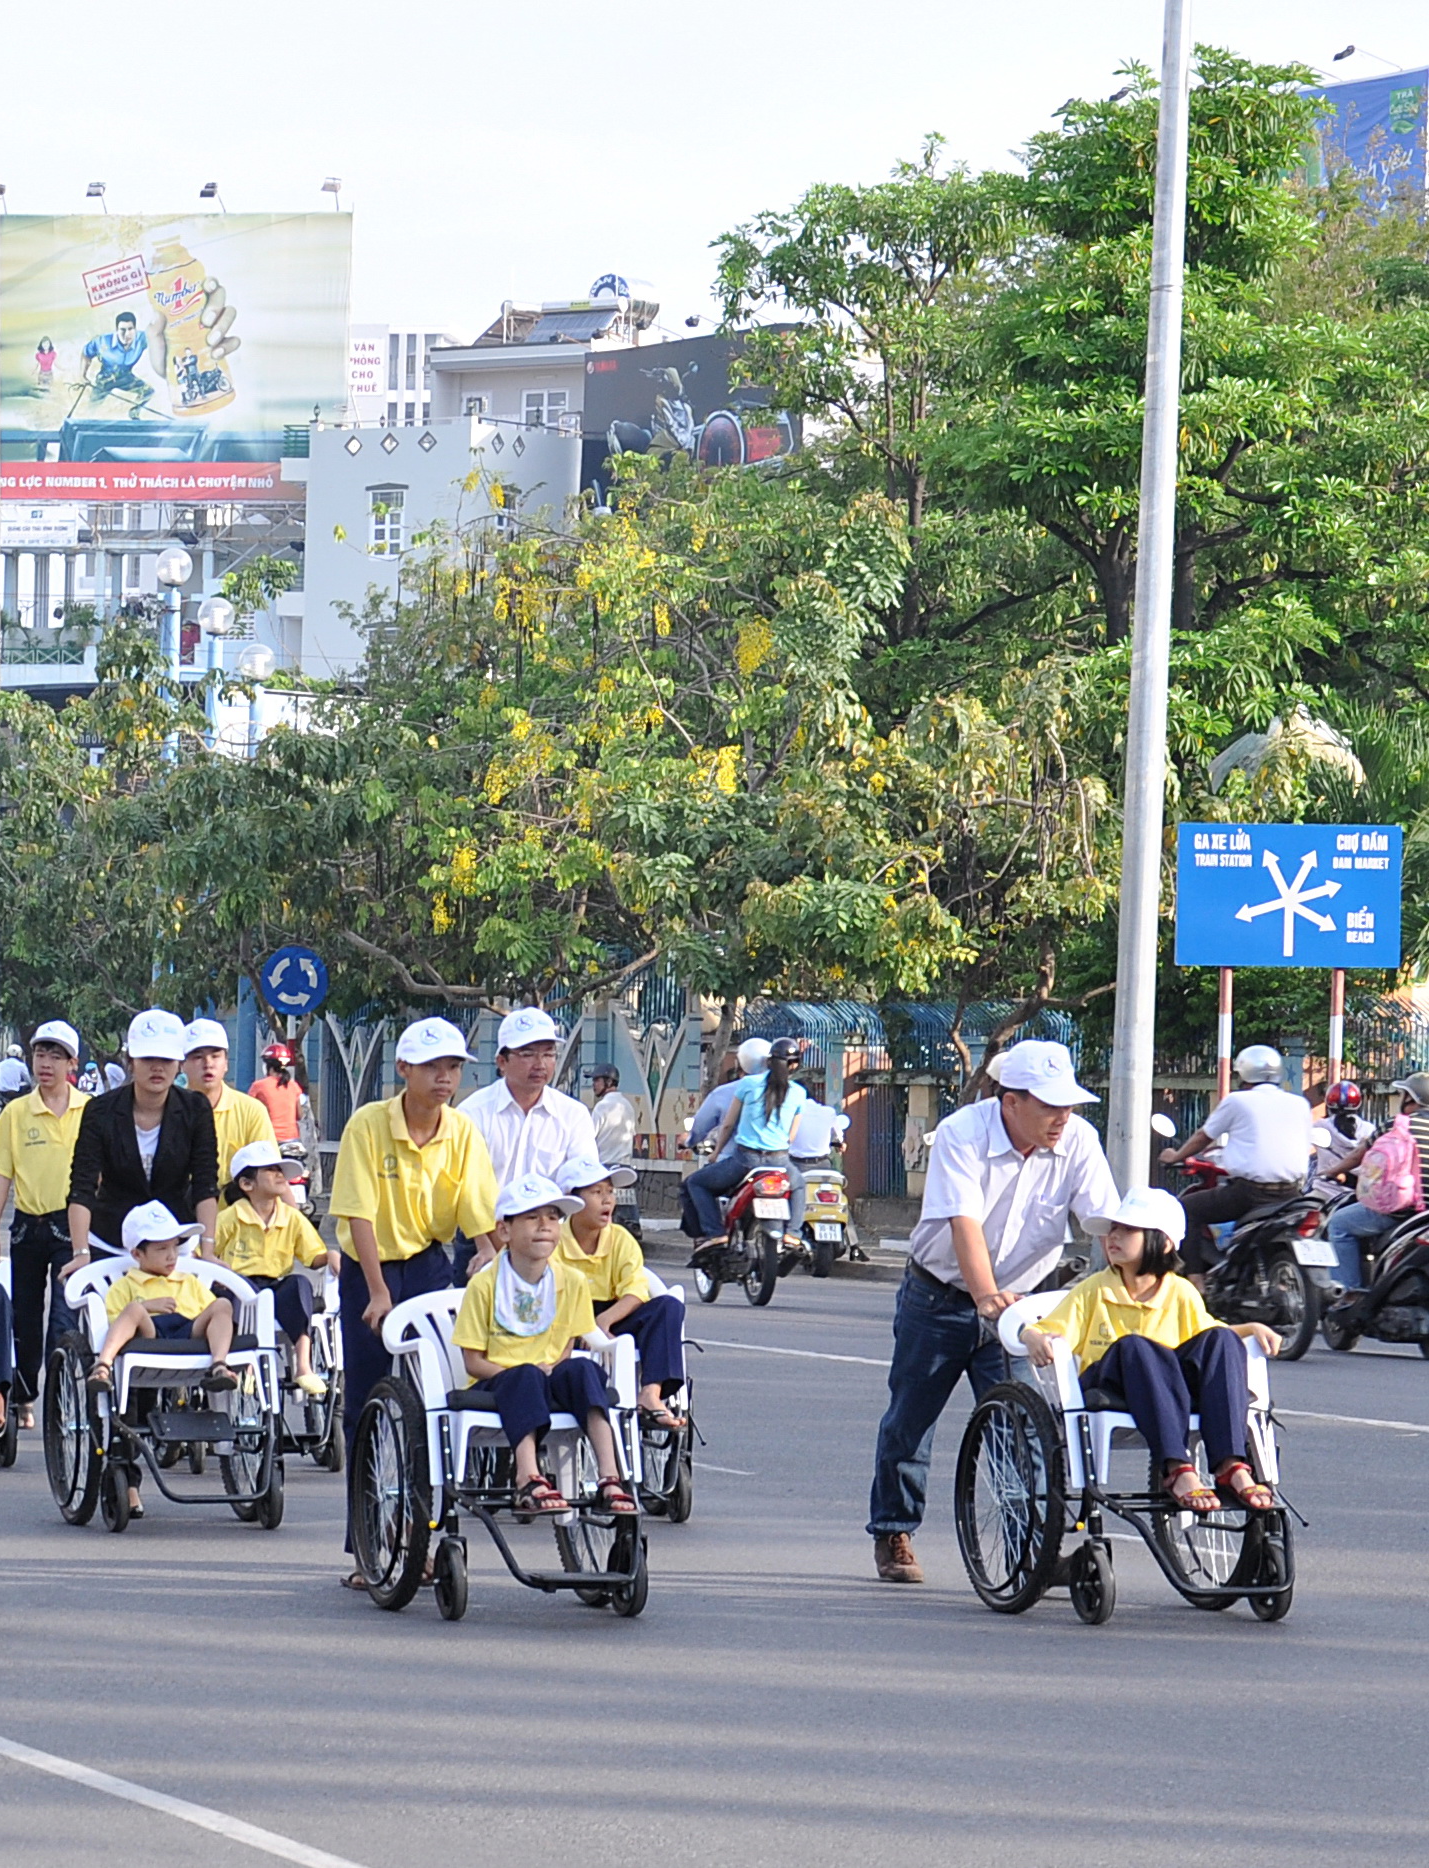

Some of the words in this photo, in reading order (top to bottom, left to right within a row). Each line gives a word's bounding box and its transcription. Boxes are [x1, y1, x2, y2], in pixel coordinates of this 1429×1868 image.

[91, 275, 129, 293] KHÔNG
[351, 370, 374, 379] CHO
[45, 476, 97, 488] NUMBER
[139, 474, 179, 488] THÁCH
[180, 474, 196, 488] LÀ
[197, 474, 246, 491] CHUYỆN
[1194, 833, 1210, 850] GA
[1211, 833, 1227, 850] XE
[1229, 828, 1251, 850] LỬA
[1336, 832, 1360, 854] CHỢ
[1194, 853, 1218, 867] TRAIN
[1219, 853, 1253, 868] STATION
[1354, 857, 1390, 870] MARKET
[1346, 905, 1375, 929] BIỂN
[1346, 931, 1375, 943] BEACH
